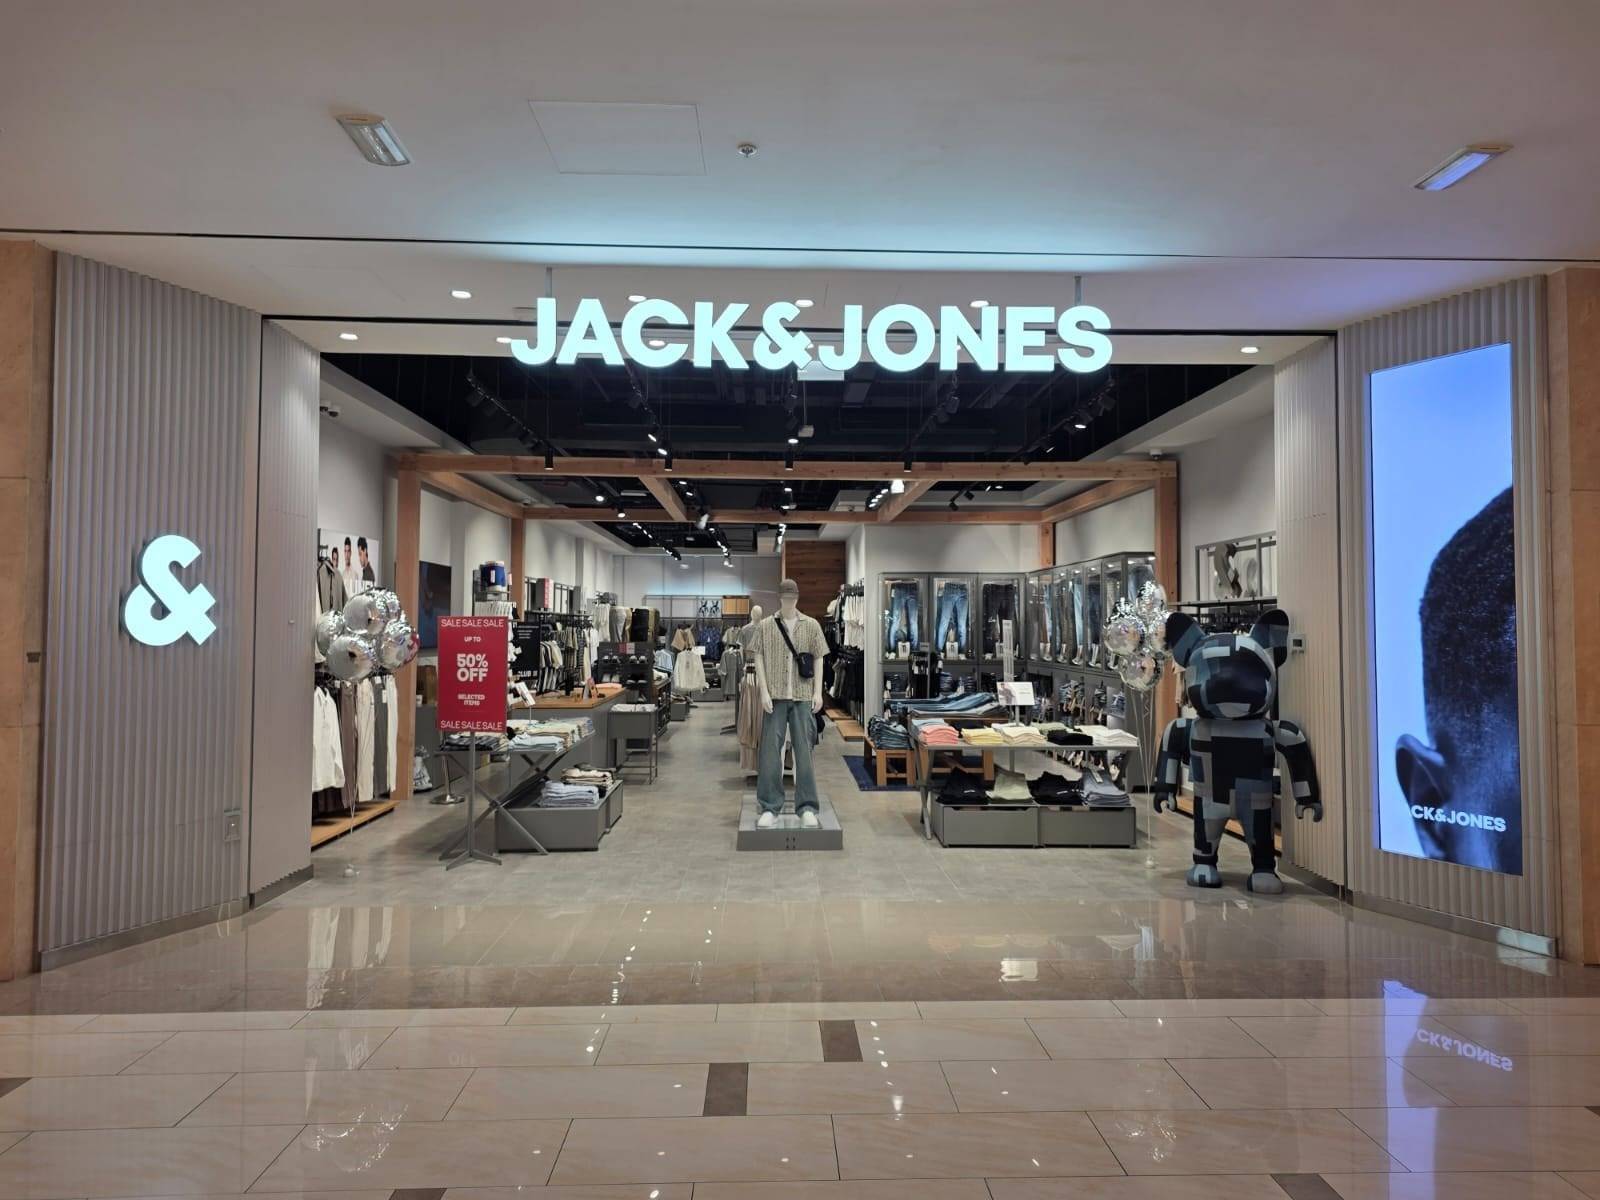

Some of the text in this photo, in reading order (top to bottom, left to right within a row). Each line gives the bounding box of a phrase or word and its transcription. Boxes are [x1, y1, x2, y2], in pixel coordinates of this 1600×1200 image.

[511, 297, 1113, 373] JACK&JONES
[124, 534, 217, 646] &
[441, 619, 504, 628] SALE SALE SALE
[456, 653, 489, 668] 50%
[456, 667, 489, 682] OFF
[441, 721, 503, 731] SALE SALE SALE
[1410, 805, 1507, 832] CK&JONES
